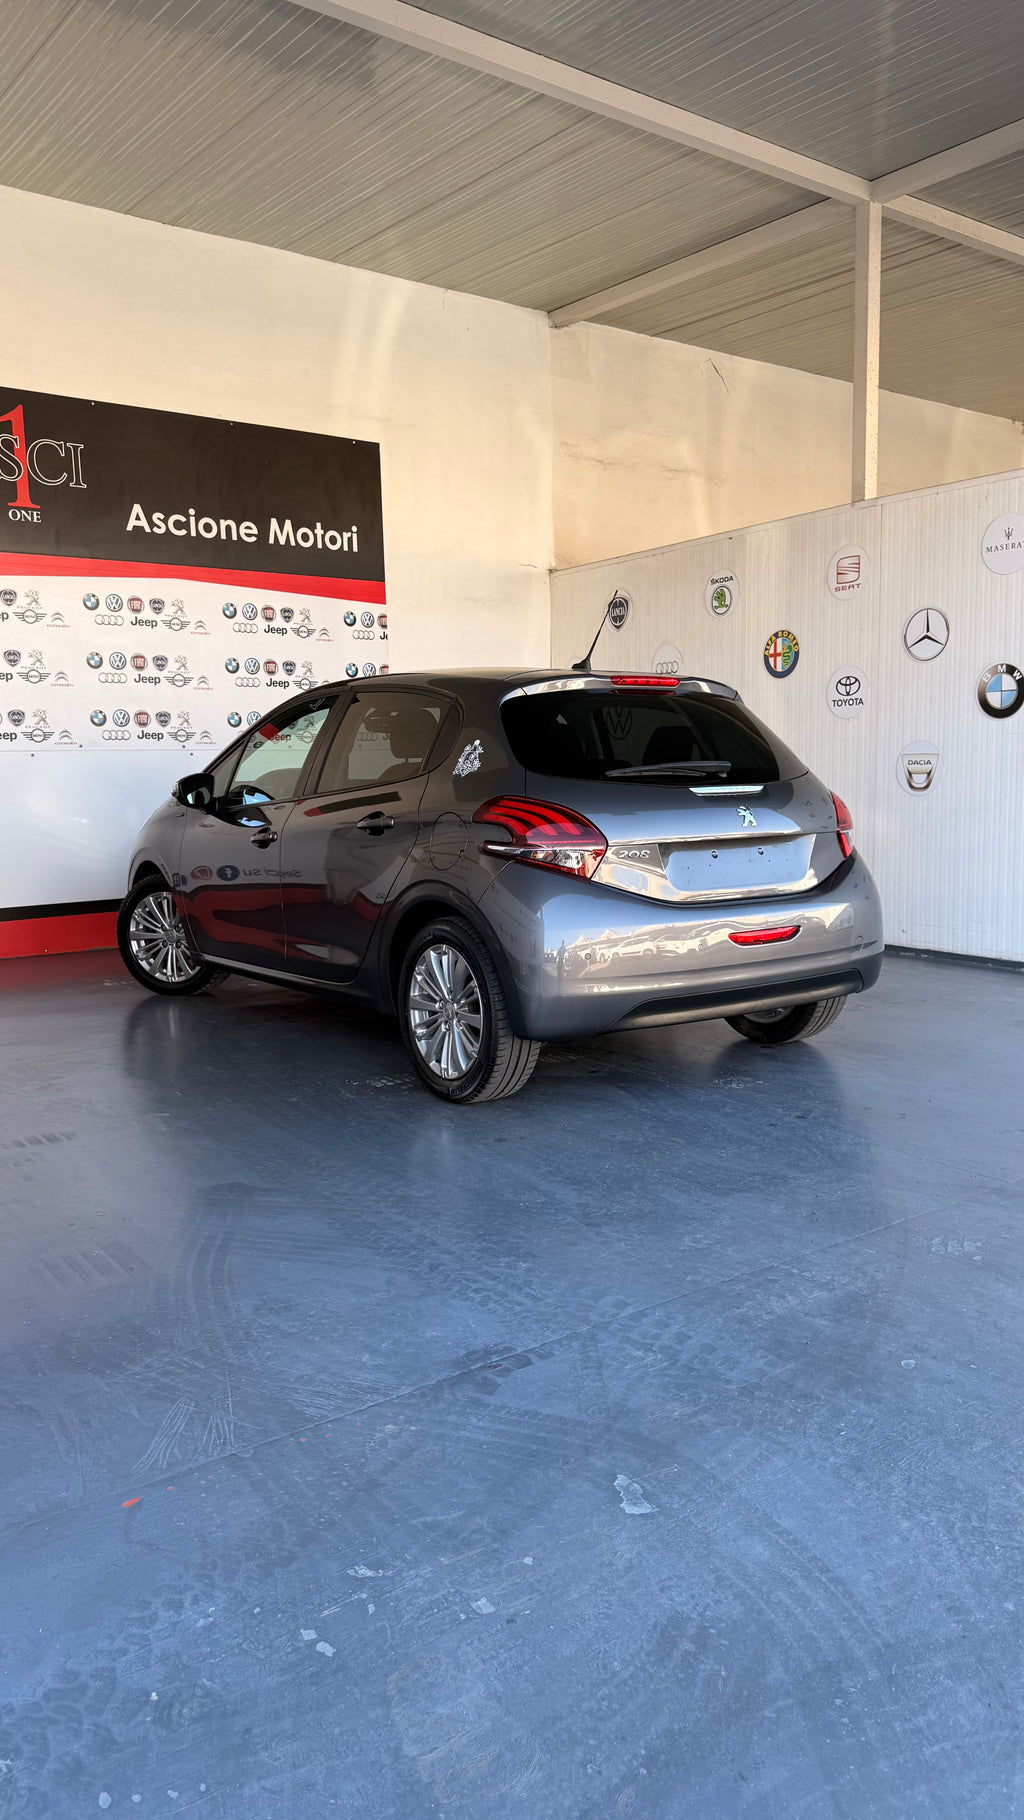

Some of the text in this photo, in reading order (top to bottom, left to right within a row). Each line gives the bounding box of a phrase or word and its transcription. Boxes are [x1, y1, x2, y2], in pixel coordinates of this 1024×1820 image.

[8, 508, 42, 523] ONE
[126, 503, 359, 553] Ascione Motori
[834, 583, 861, 592] SEAT
[0, 612, 9, 622] p
[131, 616, 158, 629] Jeep
[264, 624, 288, 636] Jeep
[764, 631, 799, 656] ALFA ROMEO
[134, 673, 161, 686] Jeep
[982, 664, 1023, 683] BMW
[266, 678, 290, 689] Jeep
[832, 697, 864, 707] TOYOTA
[137, 730, 164, 742] Jeep
[617, 850, 650, 860] 208
